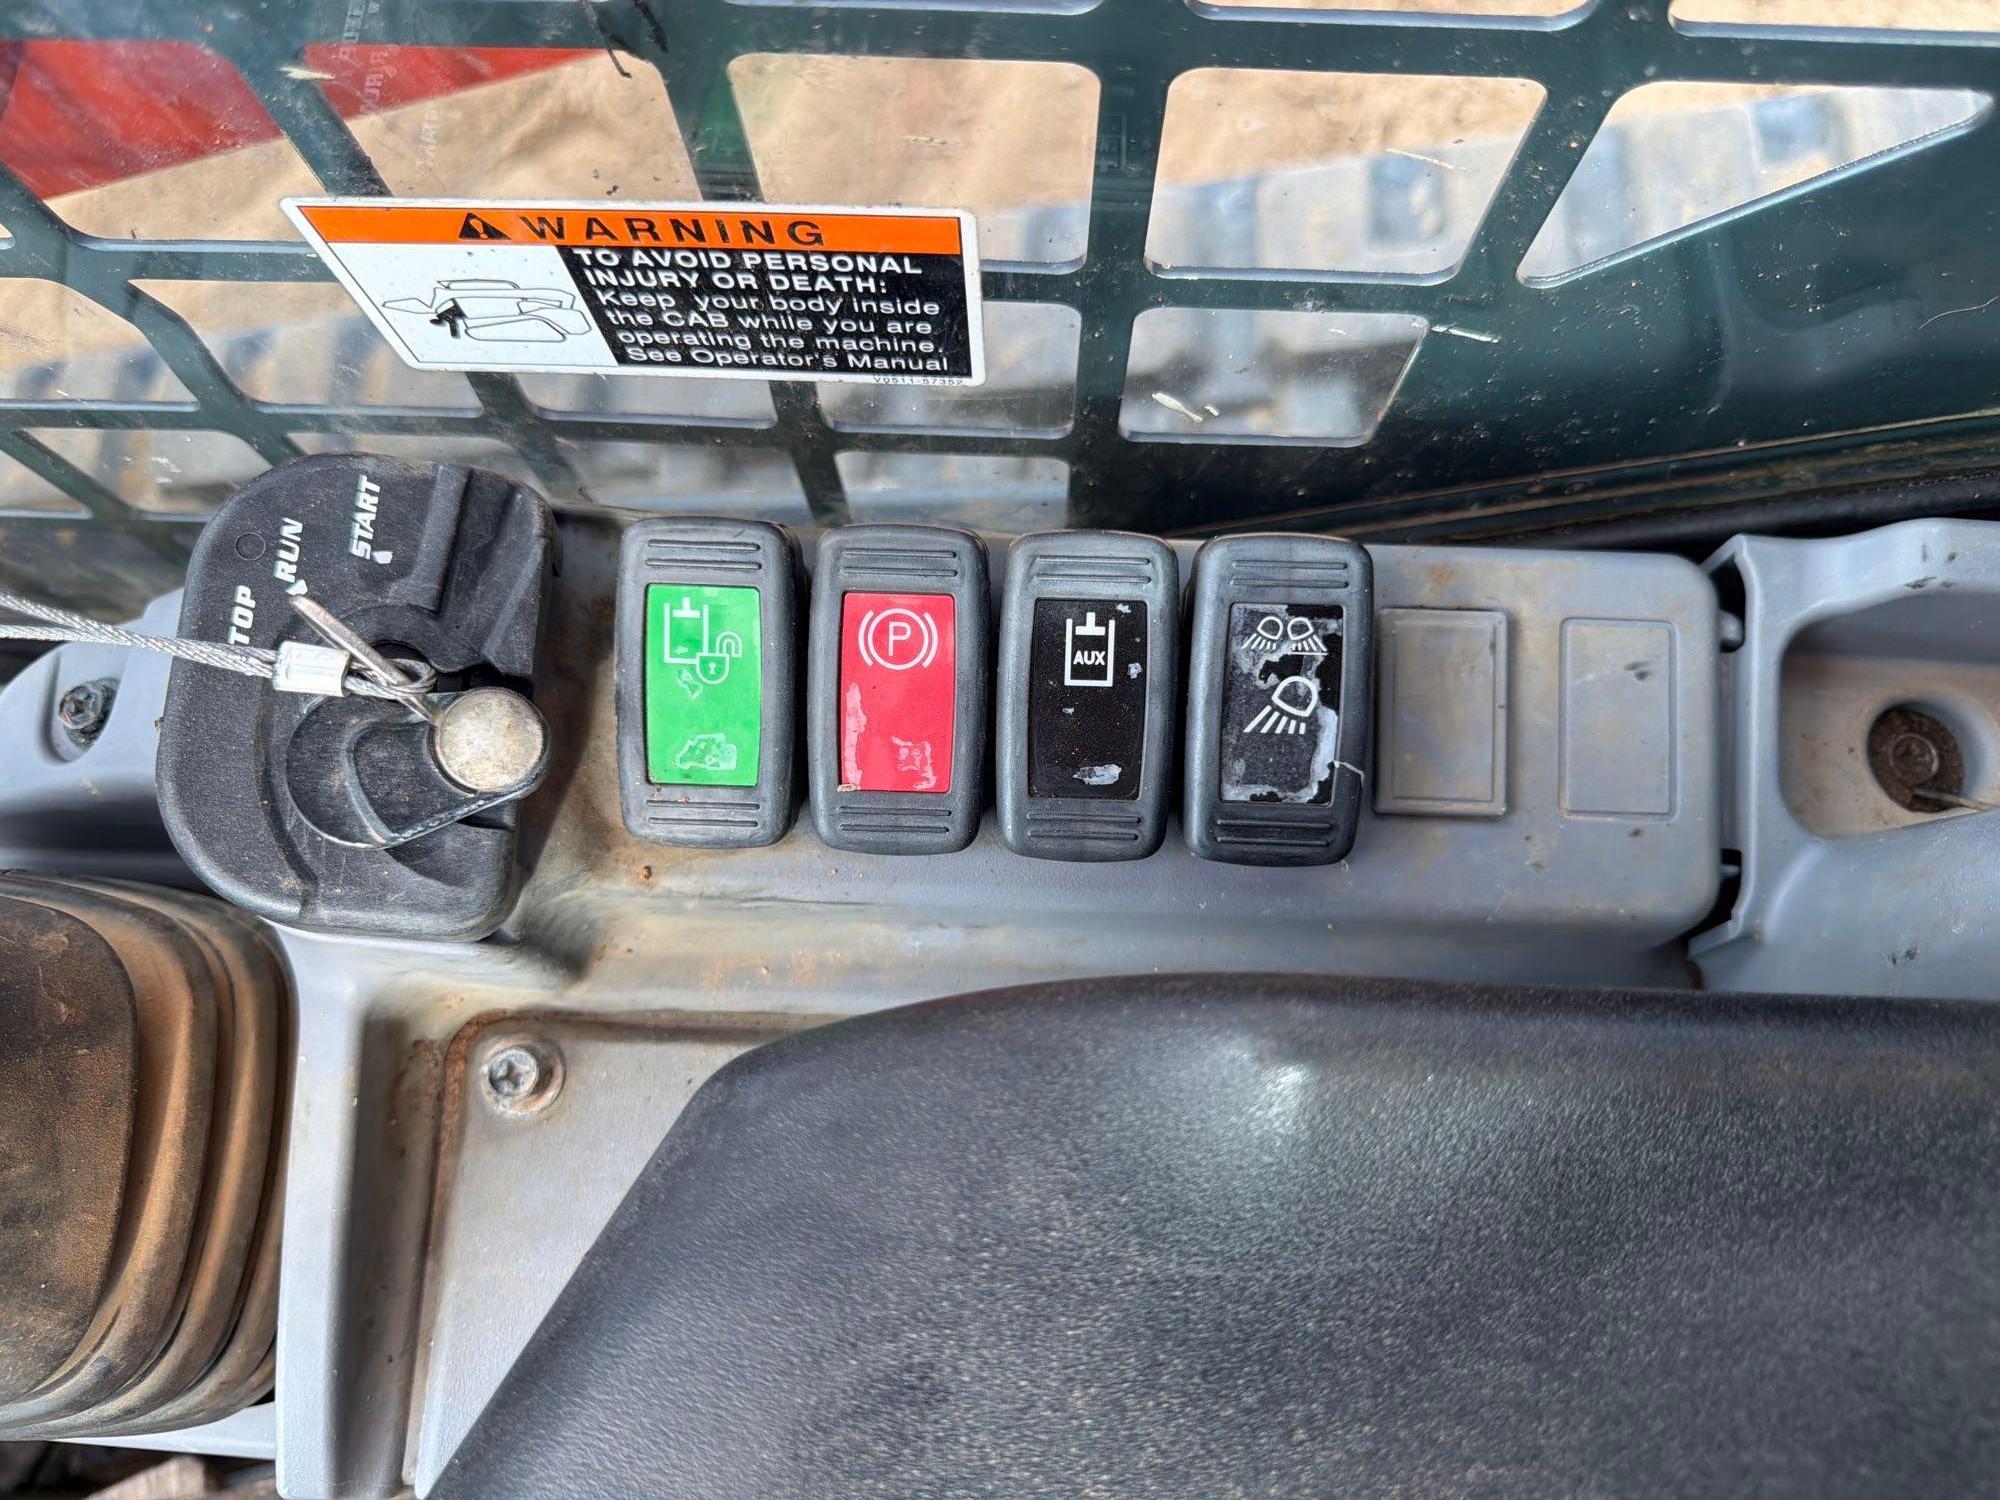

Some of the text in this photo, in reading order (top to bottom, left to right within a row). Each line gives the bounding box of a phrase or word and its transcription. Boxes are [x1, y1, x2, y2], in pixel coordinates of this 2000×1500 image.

[520, 216, 824, 246] WARNING
[572, 248, 922, 274] TO AVOID PERSONAL
[584, 268, 887, 294] INJURY OR DEATH:
[595, 289, 940, 315] Keep your body inside
[606, 308, 932, 335] the CAB while you are
[617, 330, 943, 353] operating the machine.
[626, 347, 948, 371] See Operator's Manual
[350, 474, 381, 560] START
[273, 516, 303, 583] RUN
[227, 585, 257, 645] TOP
[1073, 650, 1106, 666] AUX
